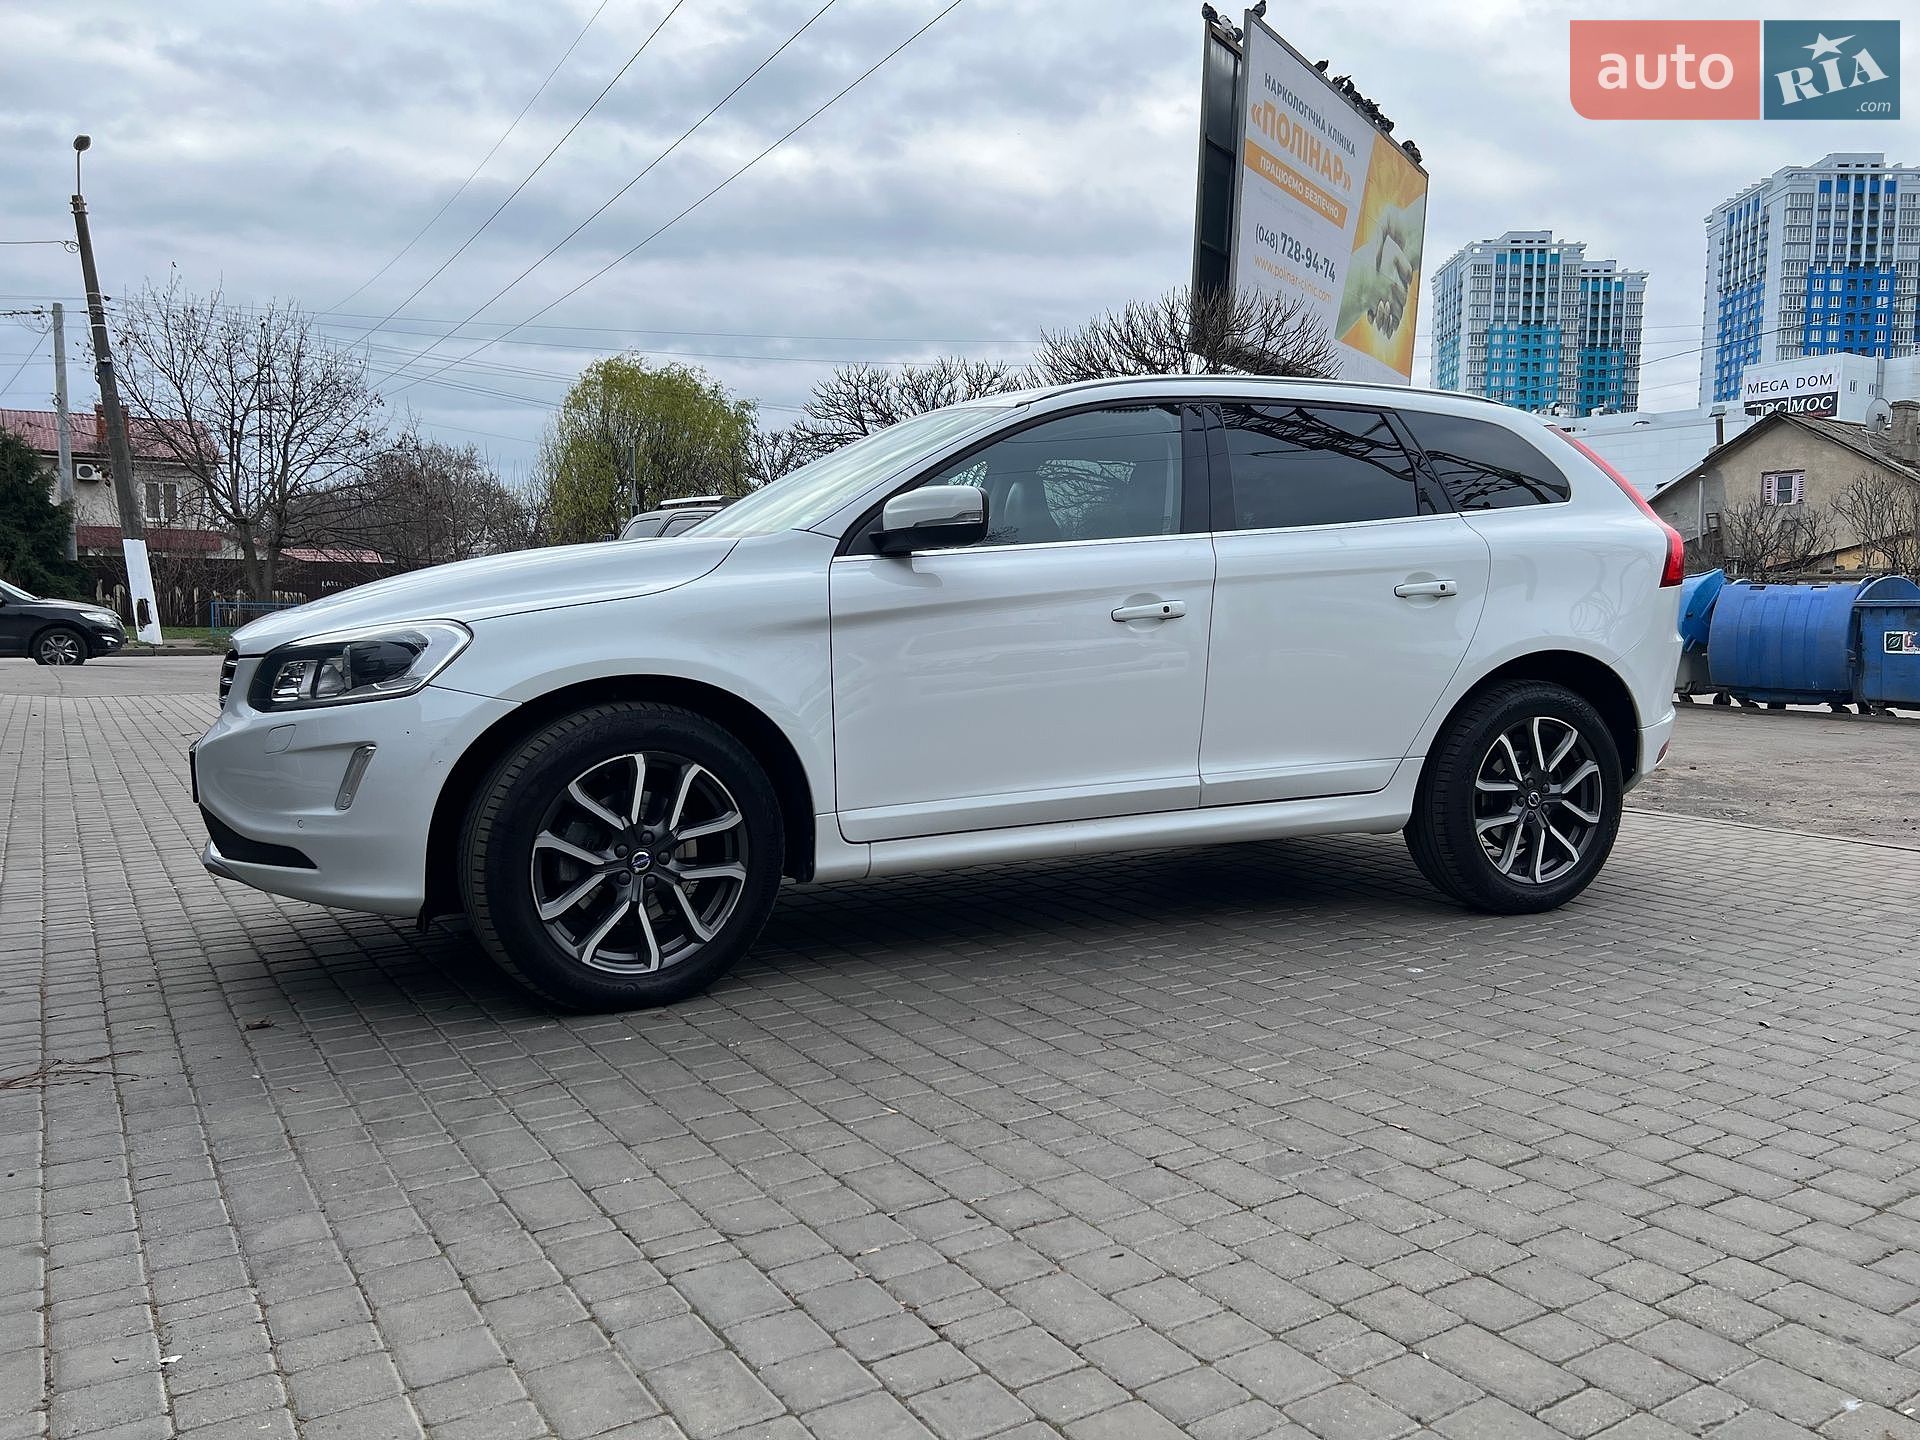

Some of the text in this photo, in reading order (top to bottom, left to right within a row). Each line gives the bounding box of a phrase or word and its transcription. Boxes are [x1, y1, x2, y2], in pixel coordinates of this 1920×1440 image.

[1264, 72, 1356, 157] НАРКОЛОГІЧНА КЛІНІКА
[1251, 100, 1352, 192] «ПОЛІНАР»
[1260, 156, 1304, 194] ПРАЦЮЄМО
[1304, 187, 1339, 218] БЕЗПЕЧНО
[1255, 223, 1336, 283] (048) 728-94-74
[1747, 373, 1833, 395] MEGA DOM
